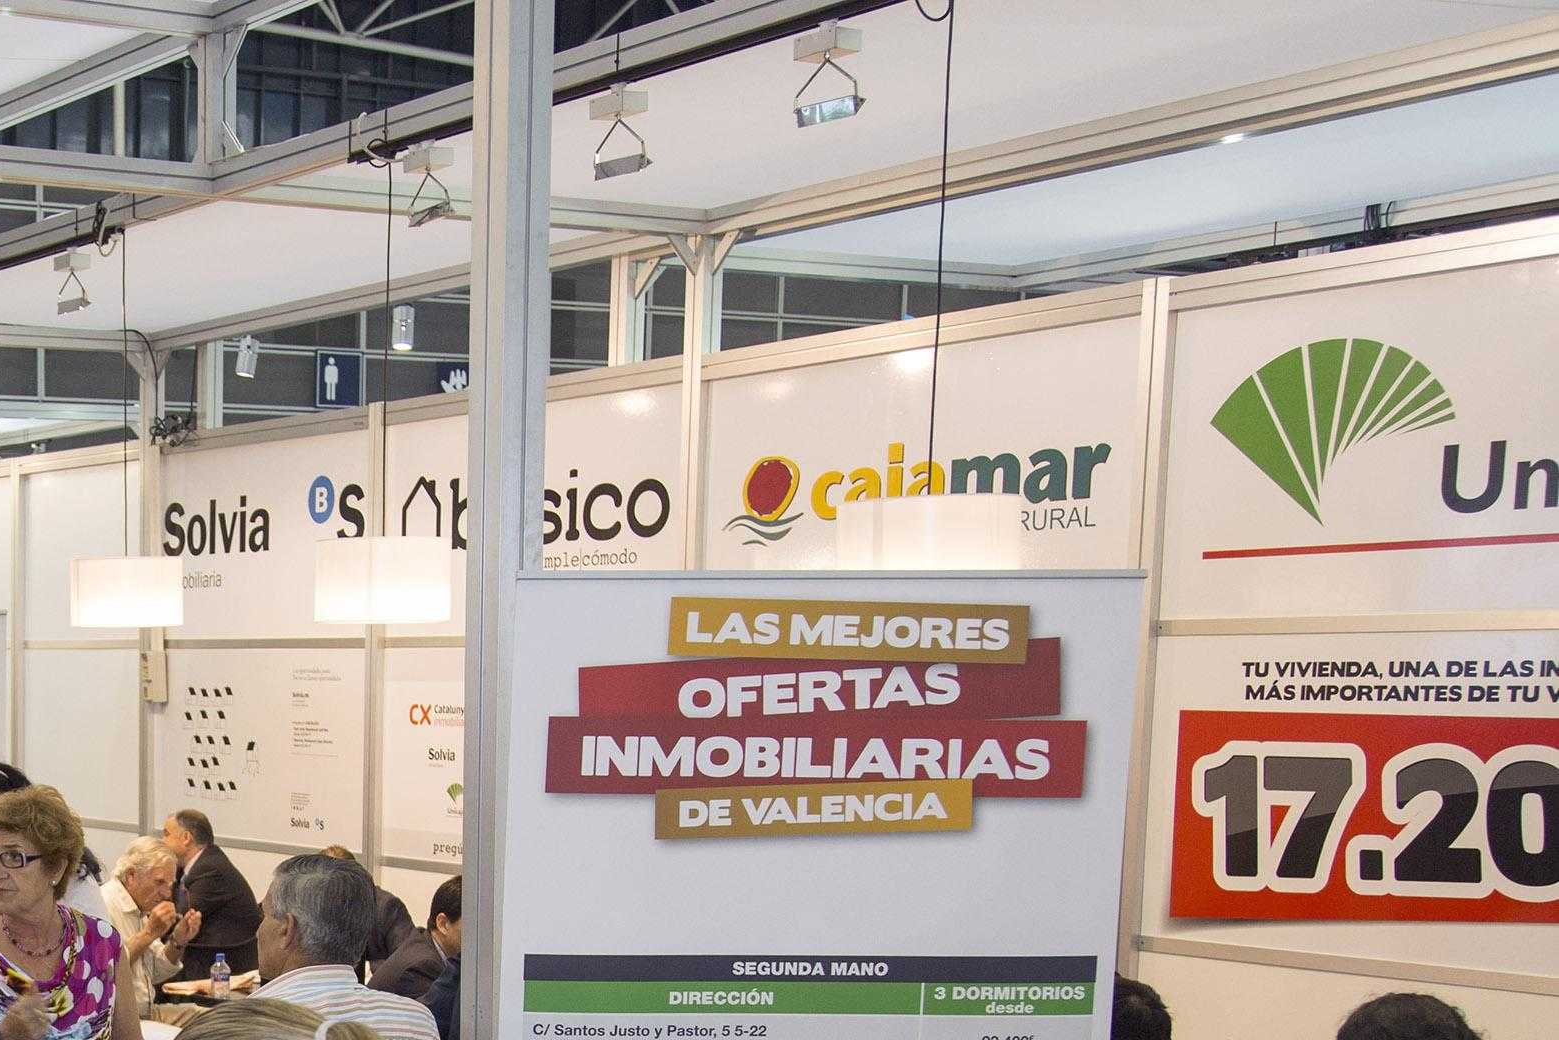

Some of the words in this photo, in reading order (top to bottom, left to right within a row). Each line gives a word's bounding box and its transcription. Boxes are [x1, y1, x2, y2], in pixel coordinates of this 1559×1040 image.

[1441, 440, 1559, 514] Un
[163, 495, 270, 557] Solvia
[686, 612, 780, 644] LAS
[789, 614, 1010, 650] MEJORES
[1242, 661, 1270, 677] TU
[1275, 661, 1383, 680] VIVIENDA,
[1389, 661, 1440, 677] UNA
[1446, 661, 1477, 678] DE
[1483, 660, 1534, 678] LAS
[678, 663, 961, 718] OFERTAS
[1245, 681, 1296, 701] MÁS
[1301, 685, 1462, 703] IMPORTANTES
[1468, 686, 1499, 702] DE
[1507, 686, 1540, 703] TU
[409, 703, 432, 726] CX
[428, 748, 456, 762] Solvia
[580, 735, 1050, 780] INMOBILIARIAS
[679, 799, 732, 827] DE
[741, 792, 948, 825] VALENCIA
[1204, 755, 1559, 888] 17.20
[732, 961, 825, 976] SEGUNDA
[831, 963, 889, 976] MANO
[669, 989, 773, 1006] DIRECCIÓN
[934, 987, 945, 999] 3
[953, 986, 1085, 1000] DORMITORIOS
[986, 1002, 1034, 1014] desde
[533, 1024, 549, 1036] C/
[554, 1024, 605, 1037] Santos
[609, 1025, 650, 1037] Justo
[654, 1028, 662, 1039] y
[667, 1025, 717, 1039] Pastor,
[721, 1026, 730, 1037] 5
[734, 1026, 767, 1037] 5-22
